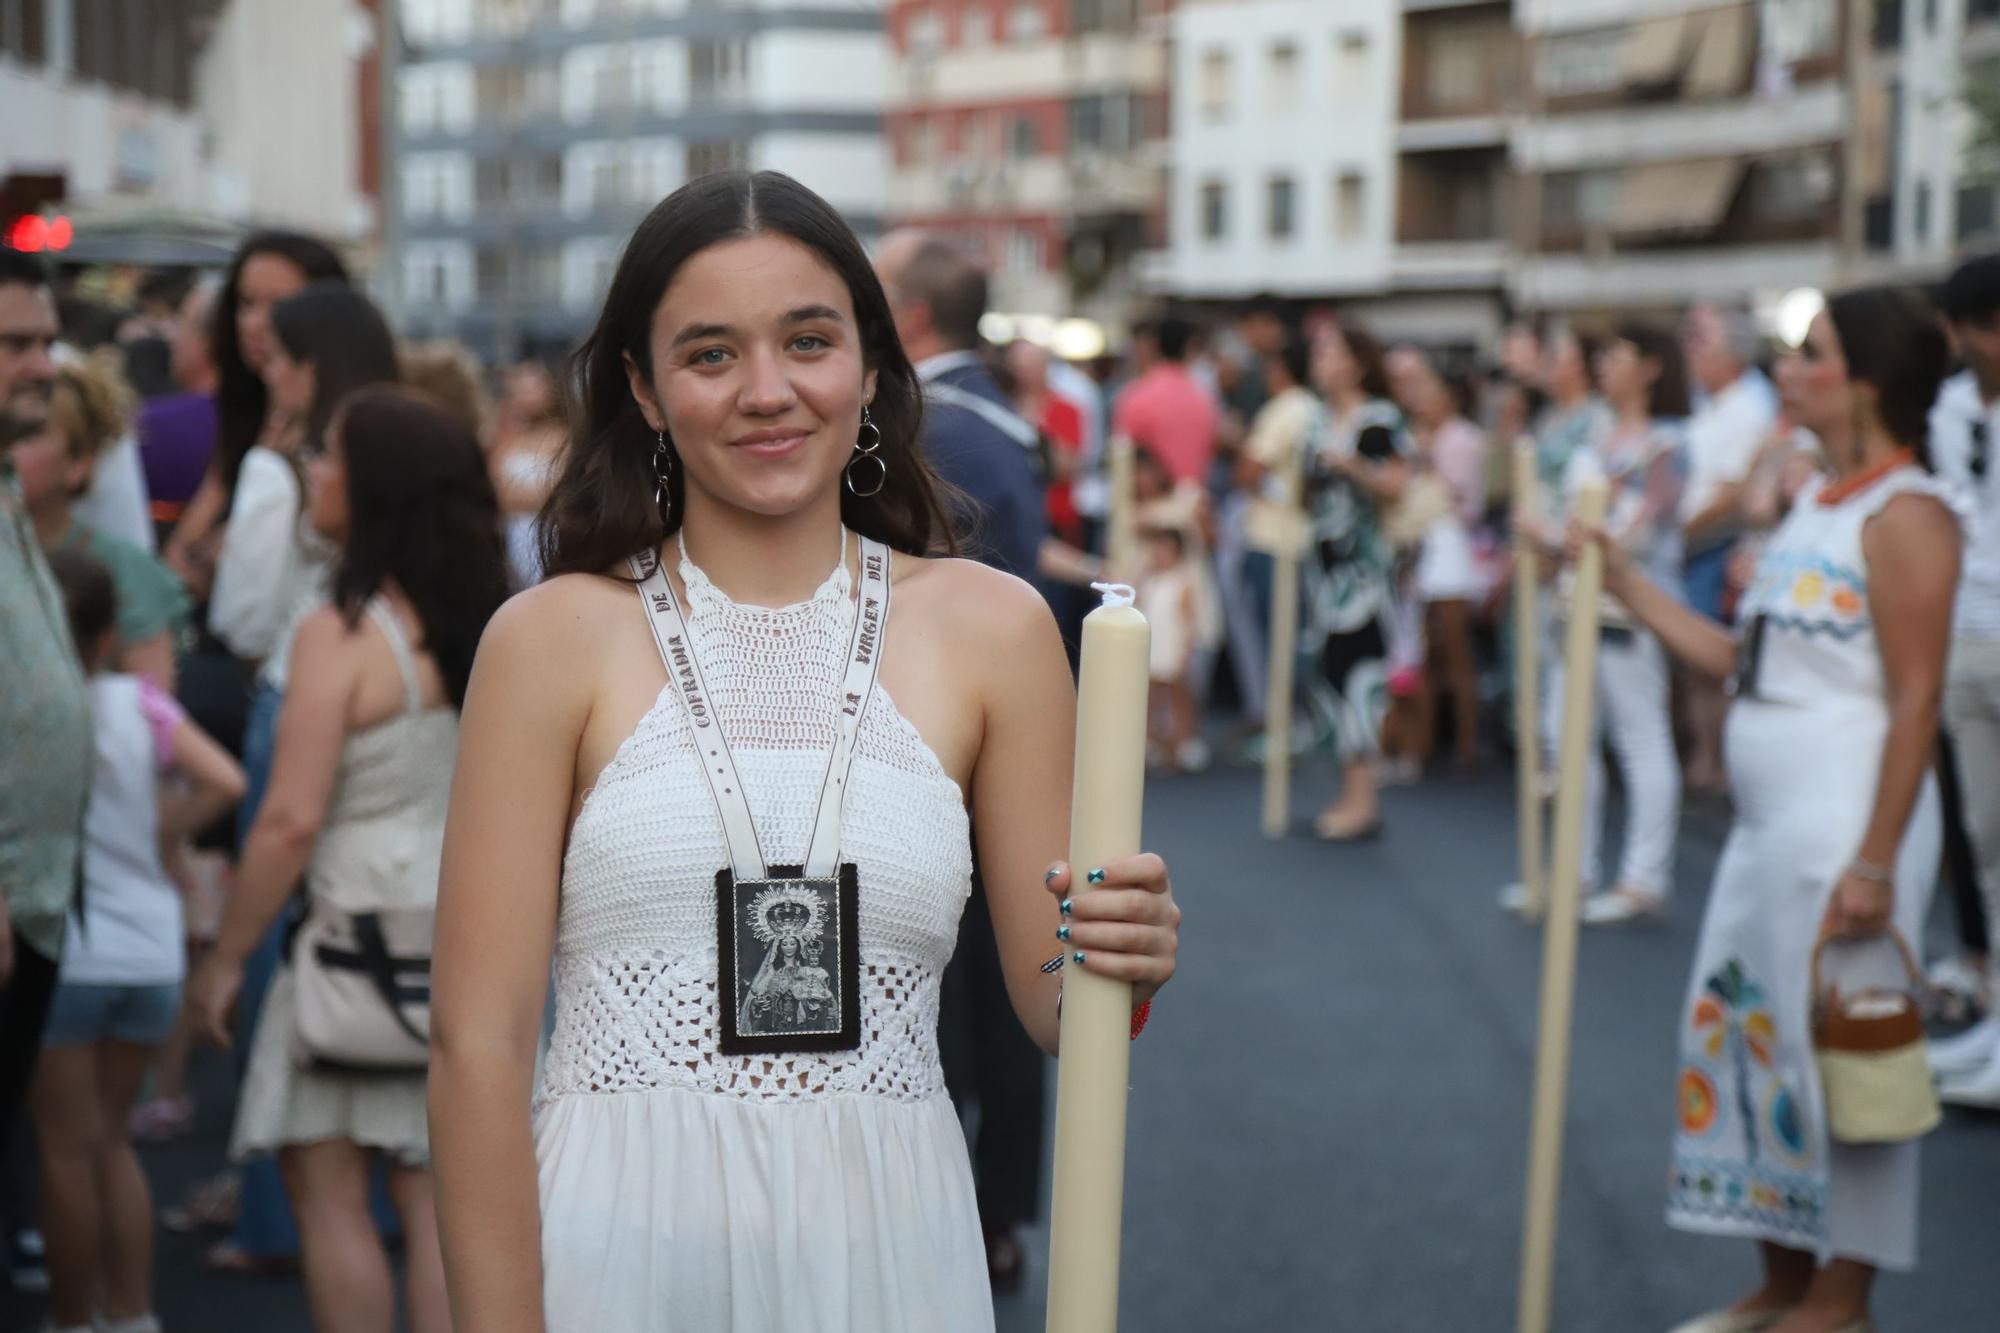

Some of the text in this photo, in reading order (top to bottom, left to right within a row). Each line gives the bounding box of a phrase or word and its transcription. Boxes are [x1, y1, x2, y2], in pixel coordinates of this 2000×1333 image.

[651, 592, 671, 613] DE
[843, 555, 882, 717] LA VIRGEN DEL
[667, 634, 711, 728] COFRADIA
